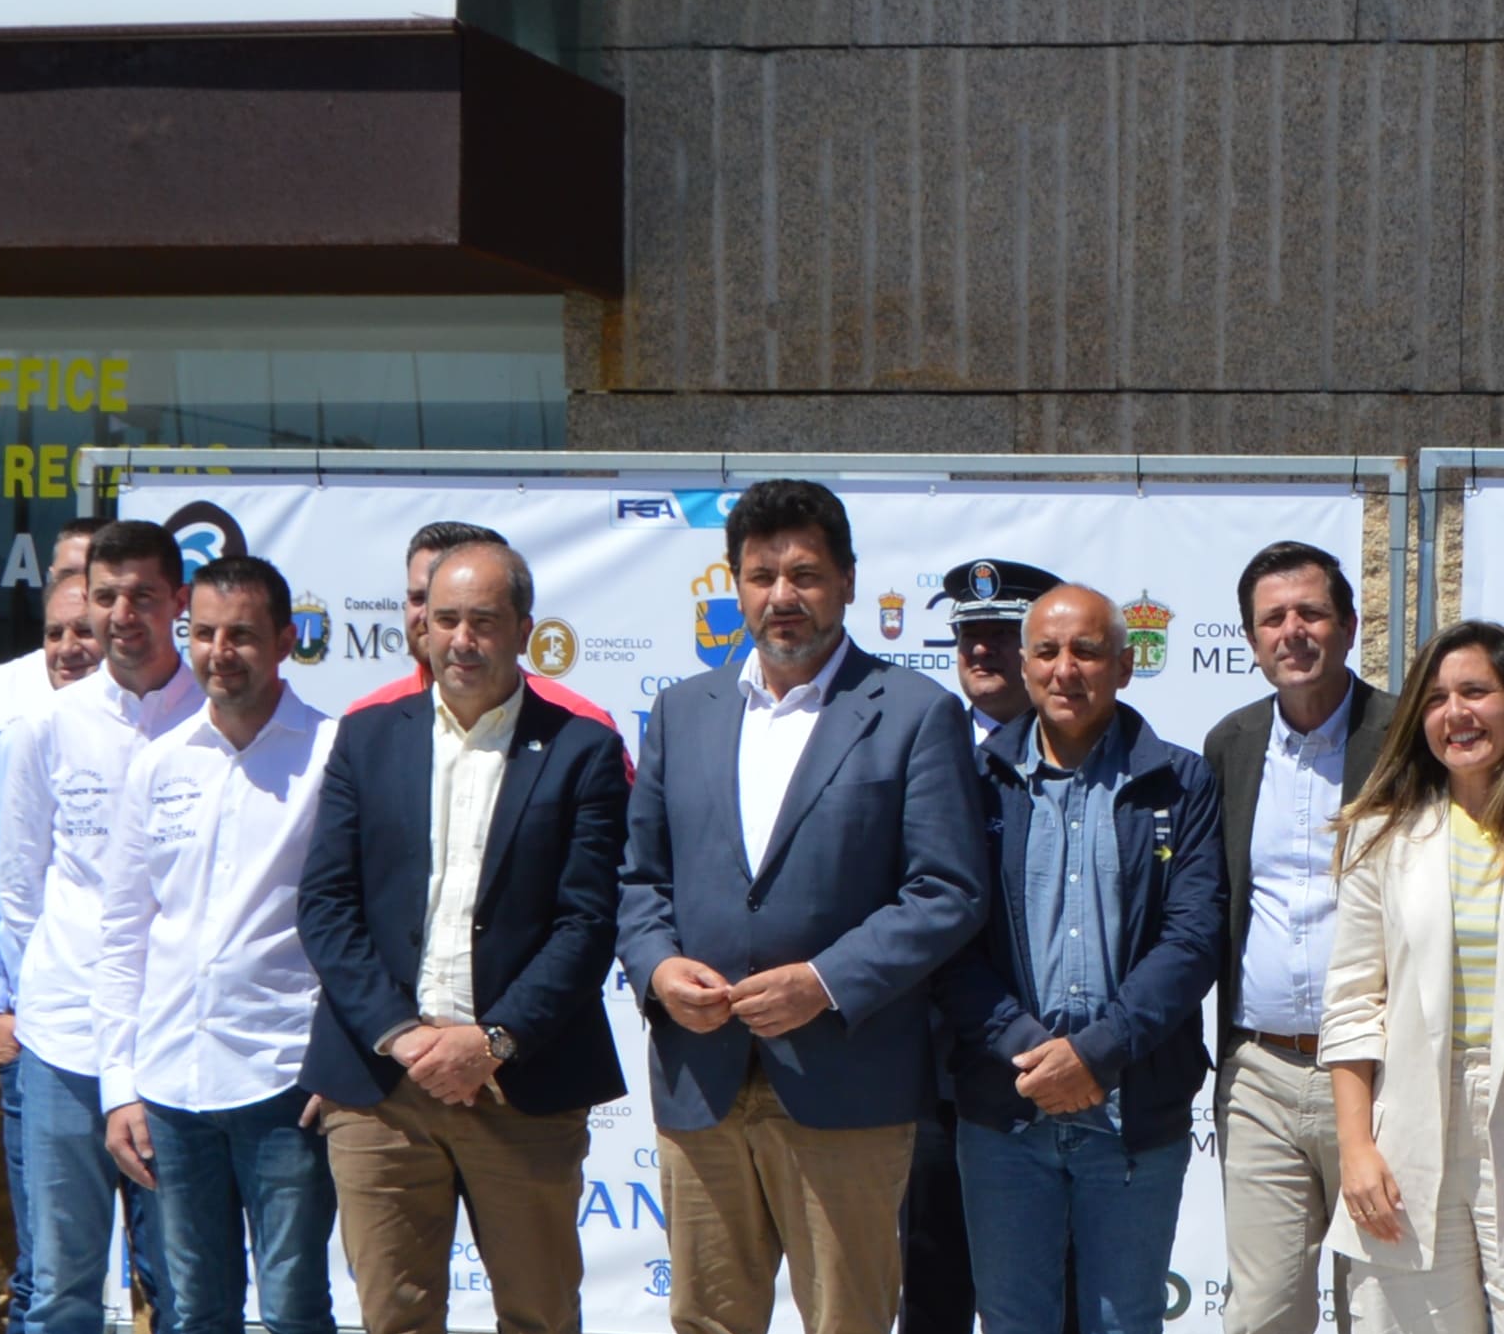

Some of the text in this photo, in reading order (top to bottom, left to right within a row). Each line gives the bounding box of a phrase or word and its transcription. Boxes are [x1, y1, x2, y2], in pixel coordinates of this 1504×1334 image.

[584, 638, 653, 650] CONCELLO
[584, 652, 636, 662] DE POIO
